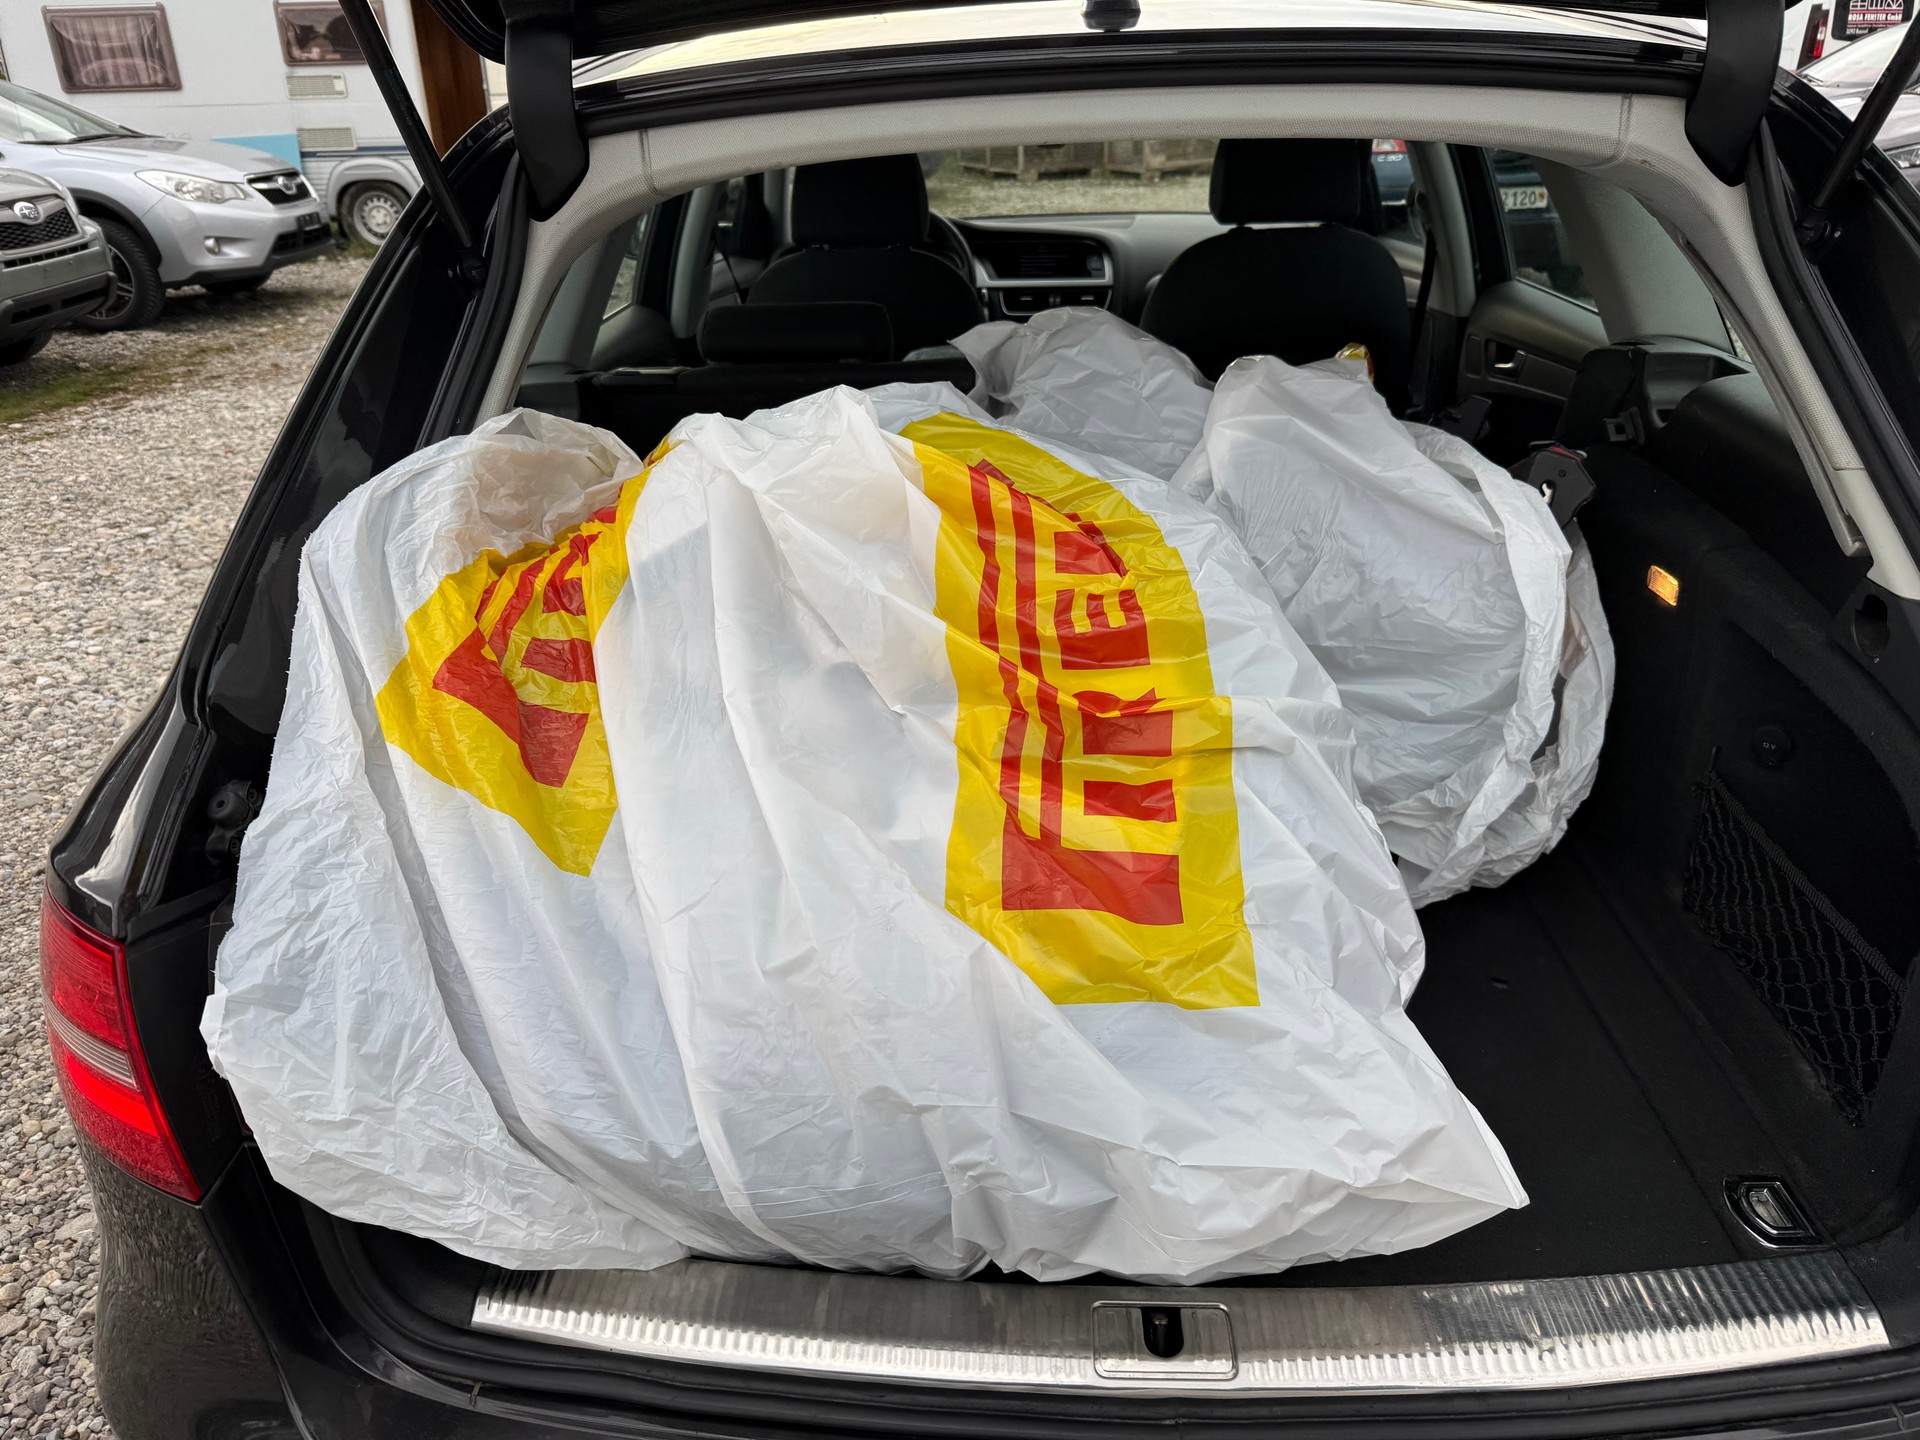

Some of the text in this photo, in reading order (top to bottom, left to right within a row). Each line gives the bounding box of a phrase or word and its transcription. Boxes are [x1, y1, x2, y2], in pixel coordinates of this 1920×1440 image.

[1848, 13, 1863, 21] ROSA
[1864, 13, 1886, 21] FENSTER
[968, 458, 1184, 925] PIREL
